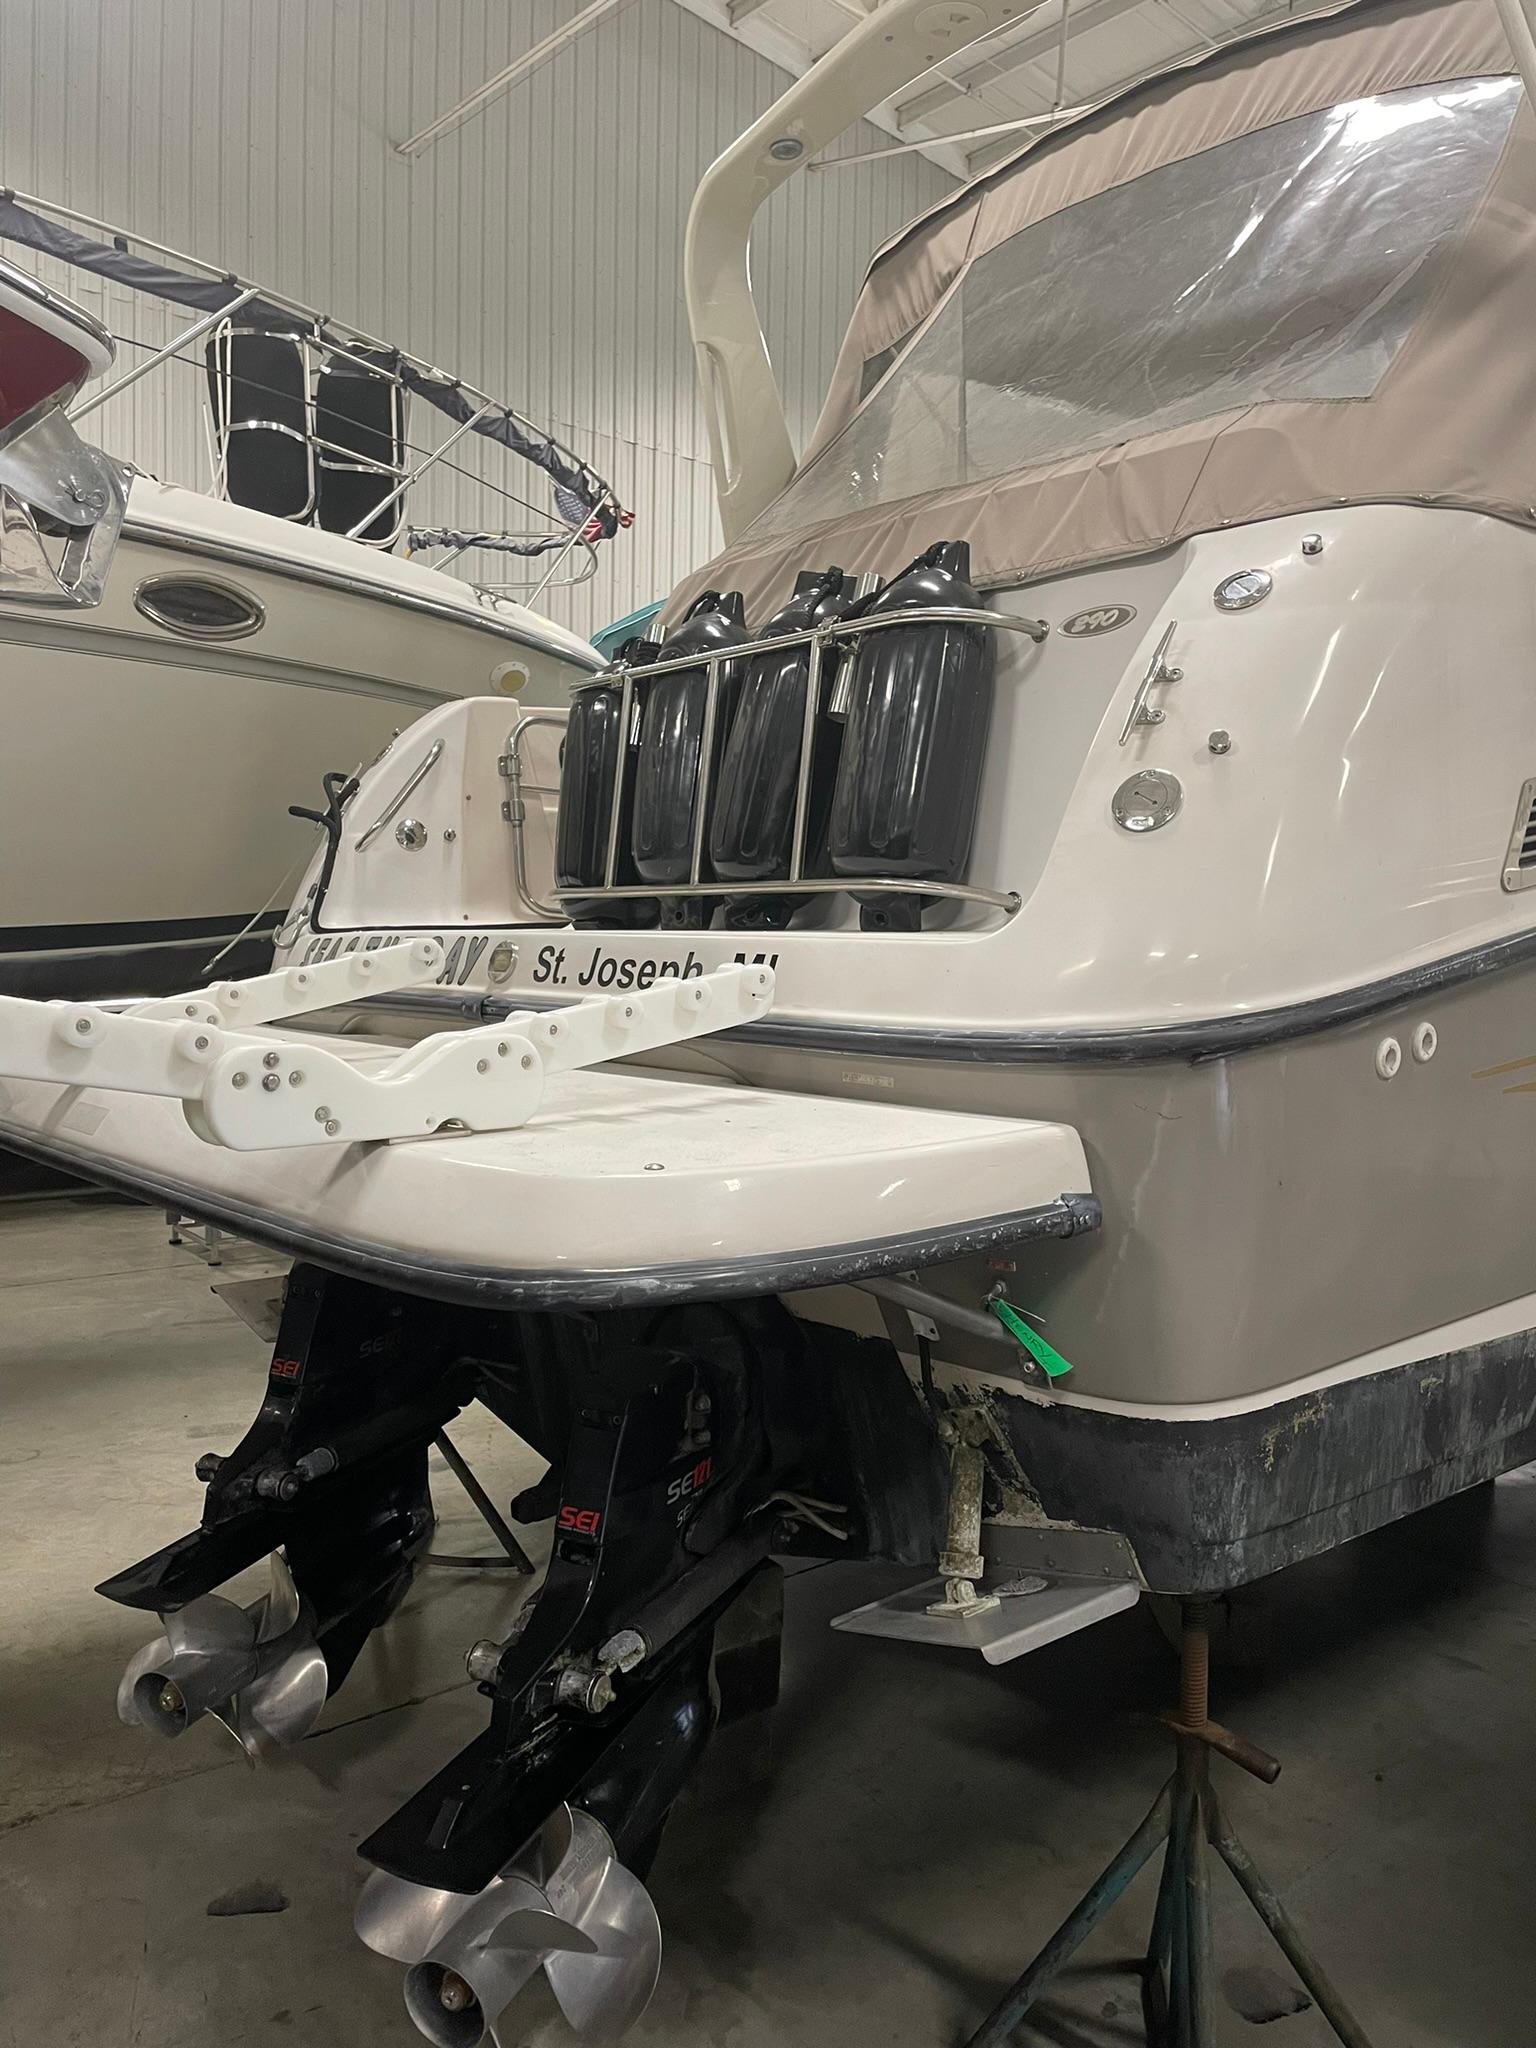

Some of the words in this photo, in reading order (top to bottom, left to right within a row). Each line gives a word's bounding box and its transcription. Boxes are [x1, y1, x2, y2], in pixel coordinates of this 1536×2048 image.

[433, 935, 490, 986] AY
[533, 945, 567, 985] St.
[271, 1357, 301, 1377] SEI
[558, 1505, 601, 1532] SEI
